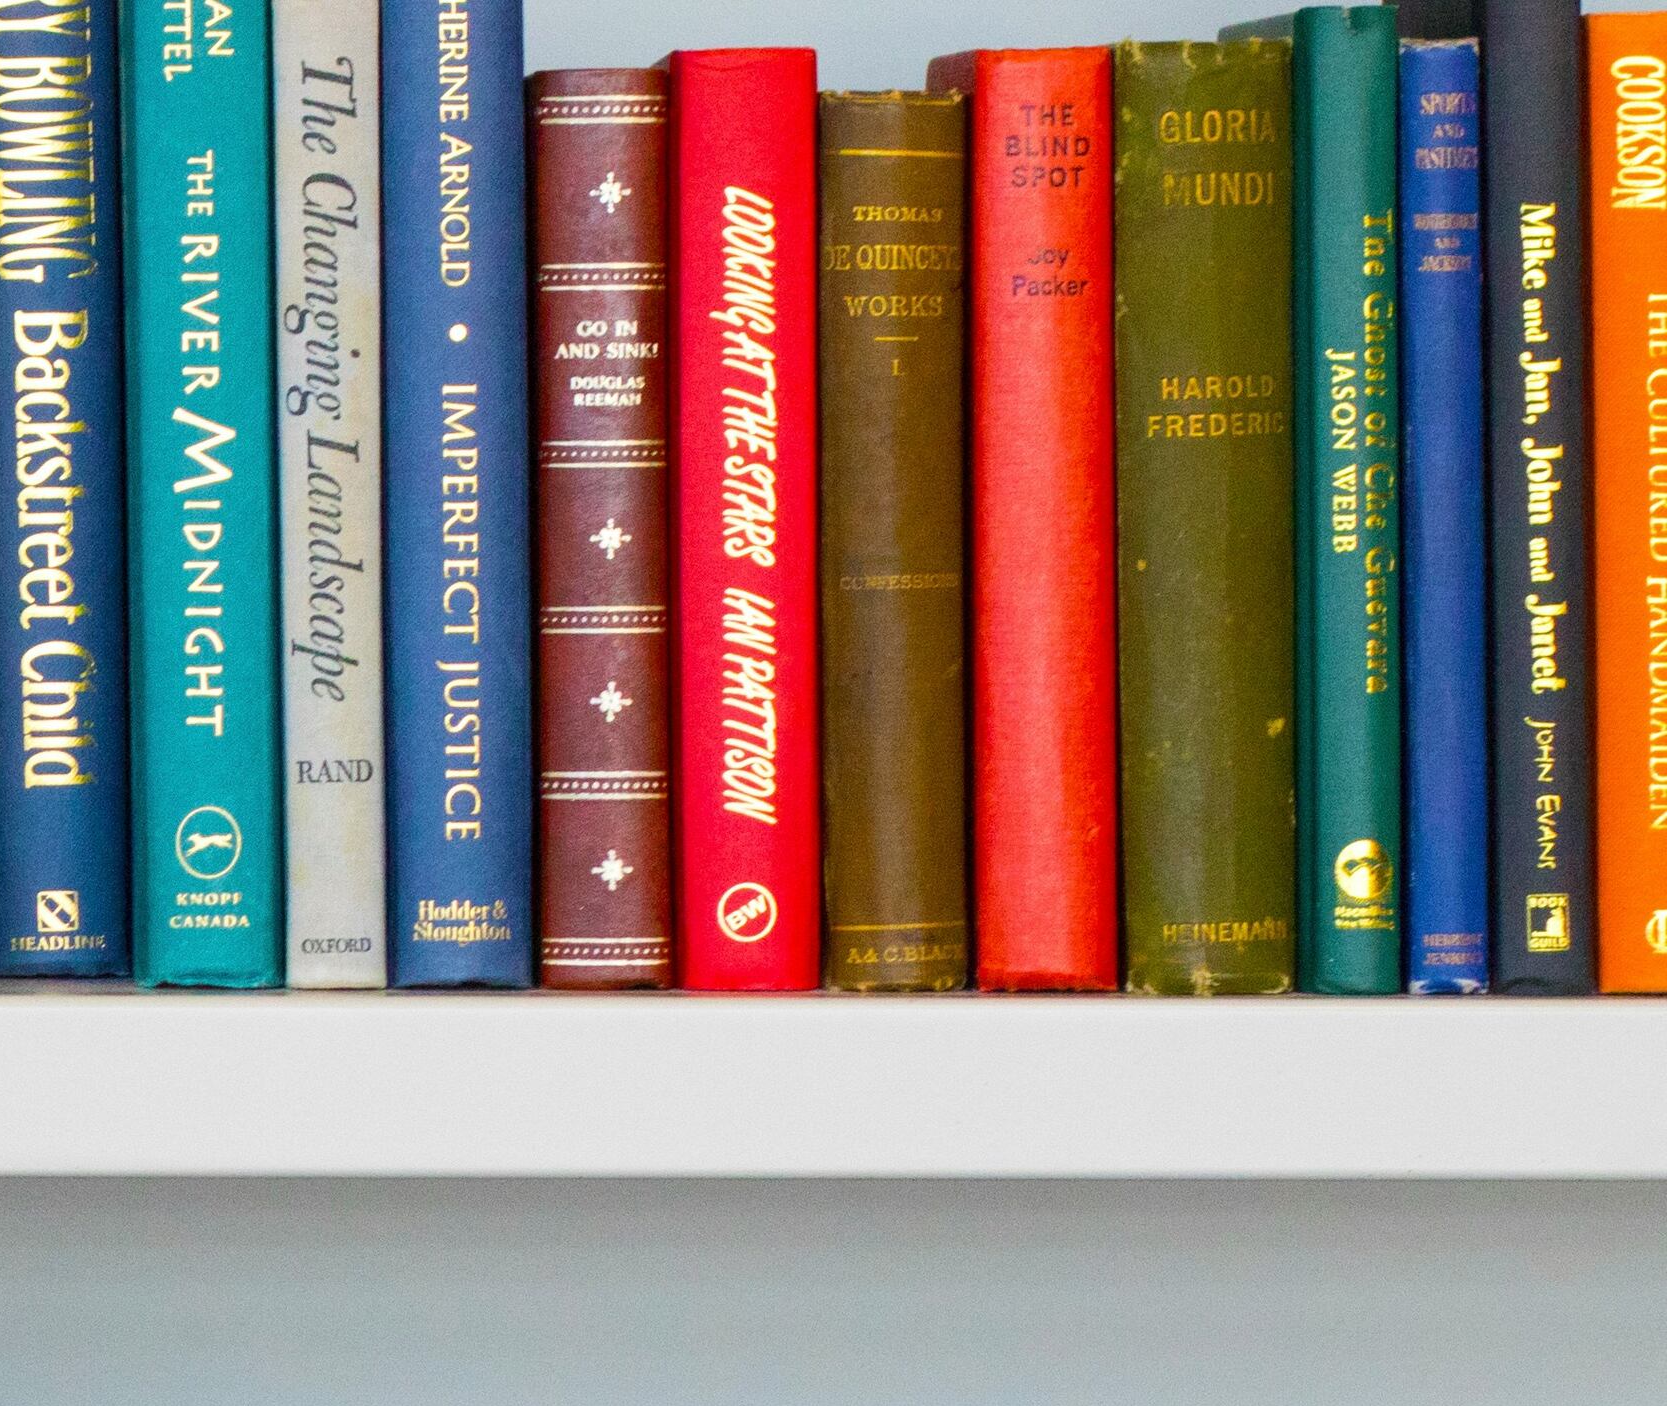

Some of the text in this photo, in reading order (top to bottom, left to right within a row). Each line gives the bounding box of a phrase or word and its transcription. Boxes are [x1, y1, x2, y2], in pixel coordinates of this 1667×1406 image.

[1006, 134, 1090, 158] BLIND
[1011, 164, 1082, 190] SPOT
[1019, 105, 1074, 126] THE
[1610, 54, 1667, 210] COOKSON
[14, 310, 87, 630] Backstreet
[172, 150, 236, 736] THE RIVER MIDNIGHT
[284, 56, 364, 701] The Changing Landscape
[1325, 349, 1357, 553] JASON WEBB
[1519, 203, 1567, 694] Mike Jan, John Janet
[437, 142, 481, 840] ARNOLD IMPERFECT JUSTICE
[710, 186, 777, 824] LOOKING AT THE STARS IAN PATTISON
[21, 640, 88, 788] Child
[169, 915, 249, 928] CANADA
